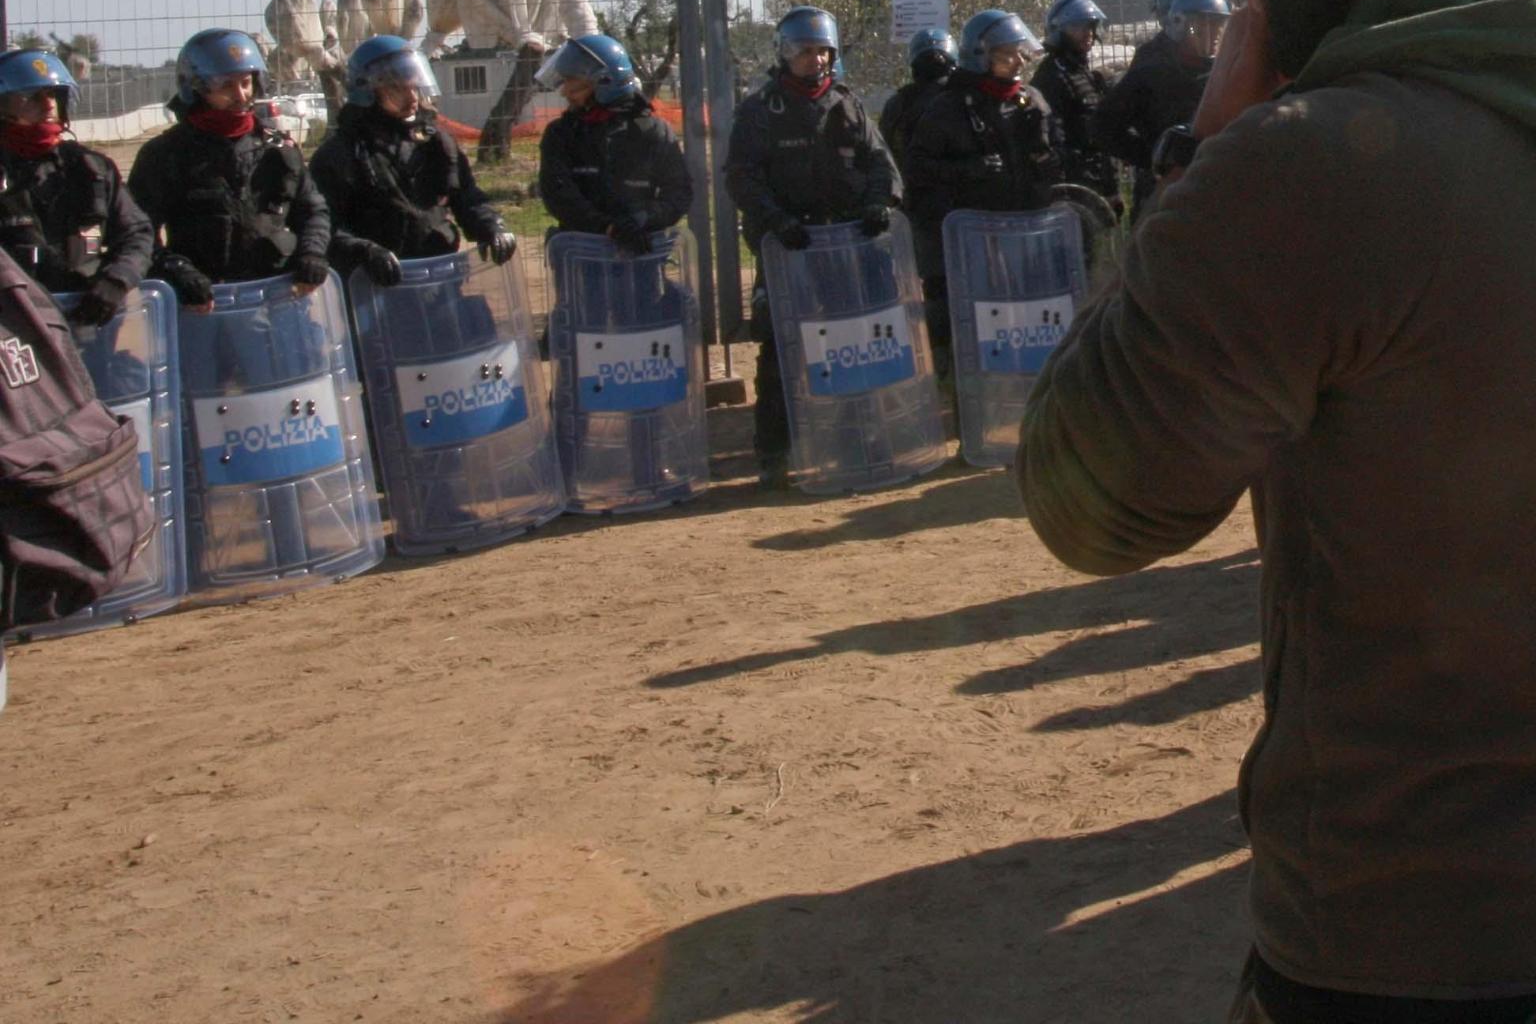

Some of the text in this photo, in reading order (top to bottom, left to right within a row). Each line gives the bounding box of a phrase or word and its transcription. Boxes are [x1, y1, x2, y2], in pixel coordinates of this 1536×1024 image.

[598, 356, 679, 387] POLIZIA
[825, 336, 904, 372] POLIZIA
[424, 379, 515, 419] POLIZIA
[224, 415, 328, 457] POLIZIA
